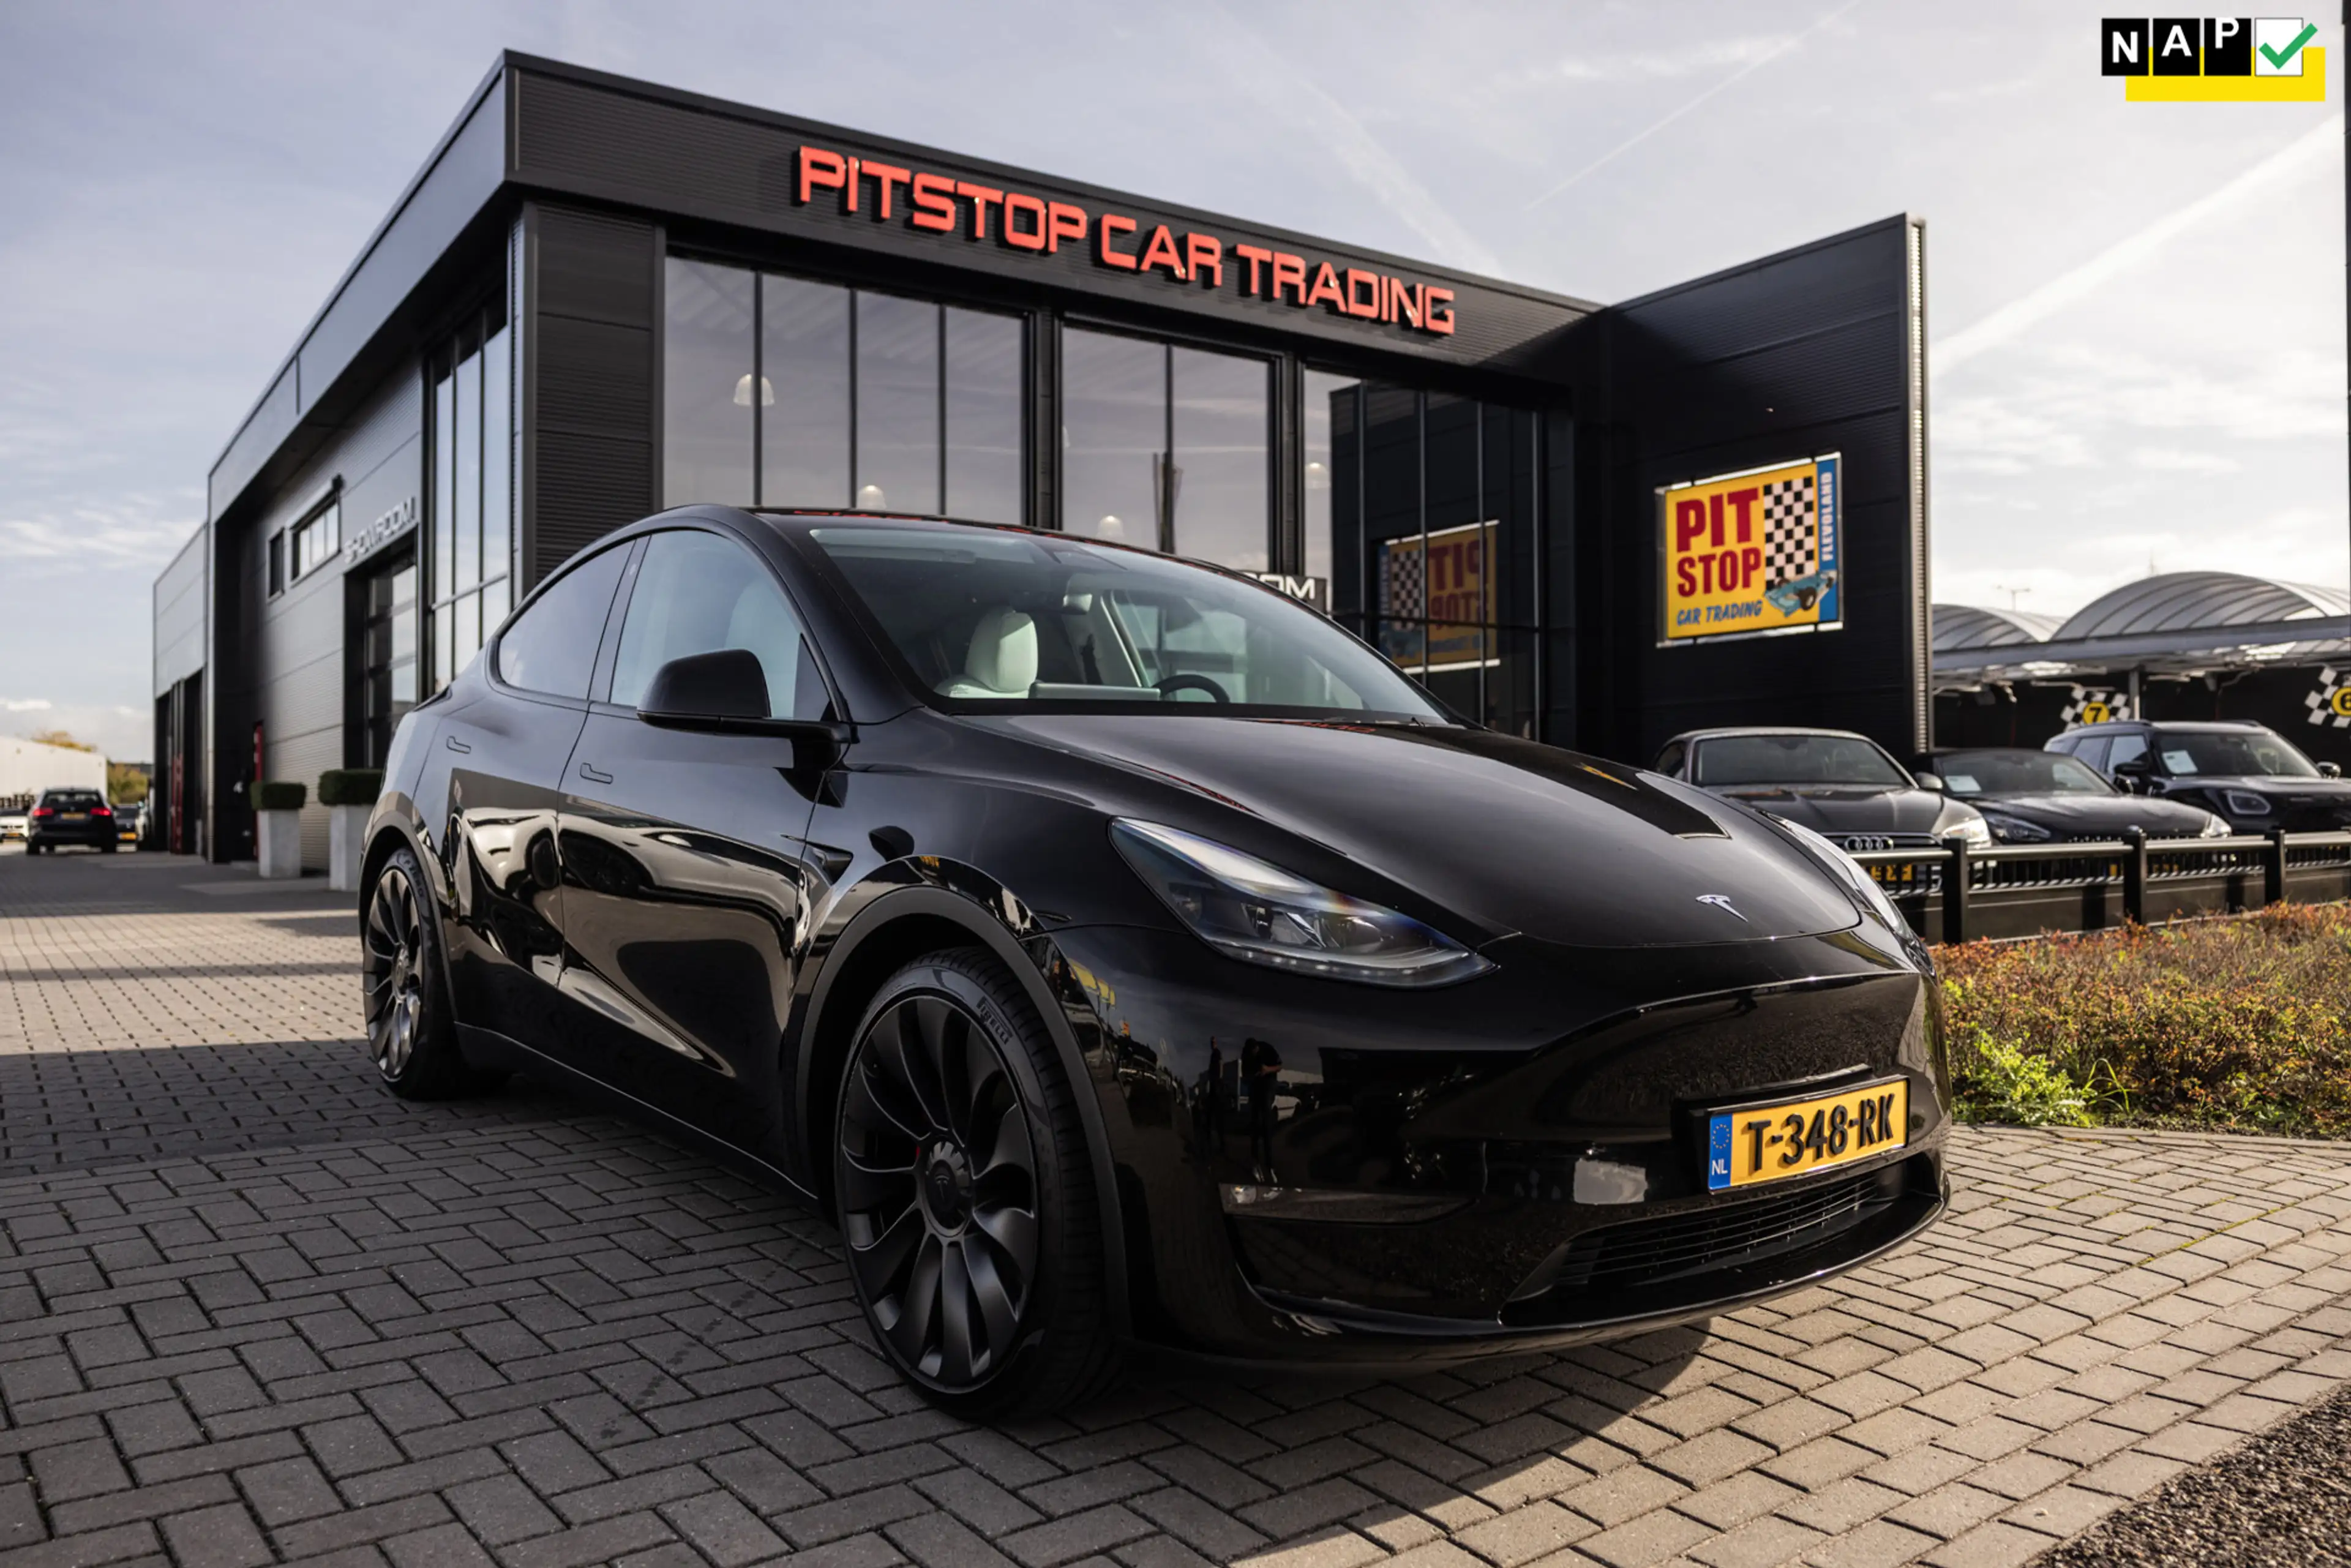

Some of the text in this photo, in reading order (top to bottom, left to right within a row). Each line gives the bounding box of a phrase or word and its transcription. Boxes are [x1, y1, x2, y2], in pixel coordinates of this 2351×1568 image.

[800, 146, 1454, 334] PITSTOP CAR TRADING
[1676, 487, 1760, 553] PIT
[1820, 471, 1834, 562] FLEVOLAND
[1677, 547, 1761, 598] STOP
[1676, 600, 1763, 626] CAR TRADING
[2089, 707, 2103, 723] 7
[1747, 1093, 1895, 1171] T-348-RK
[1711, 1158, 1728, 1176] NL
